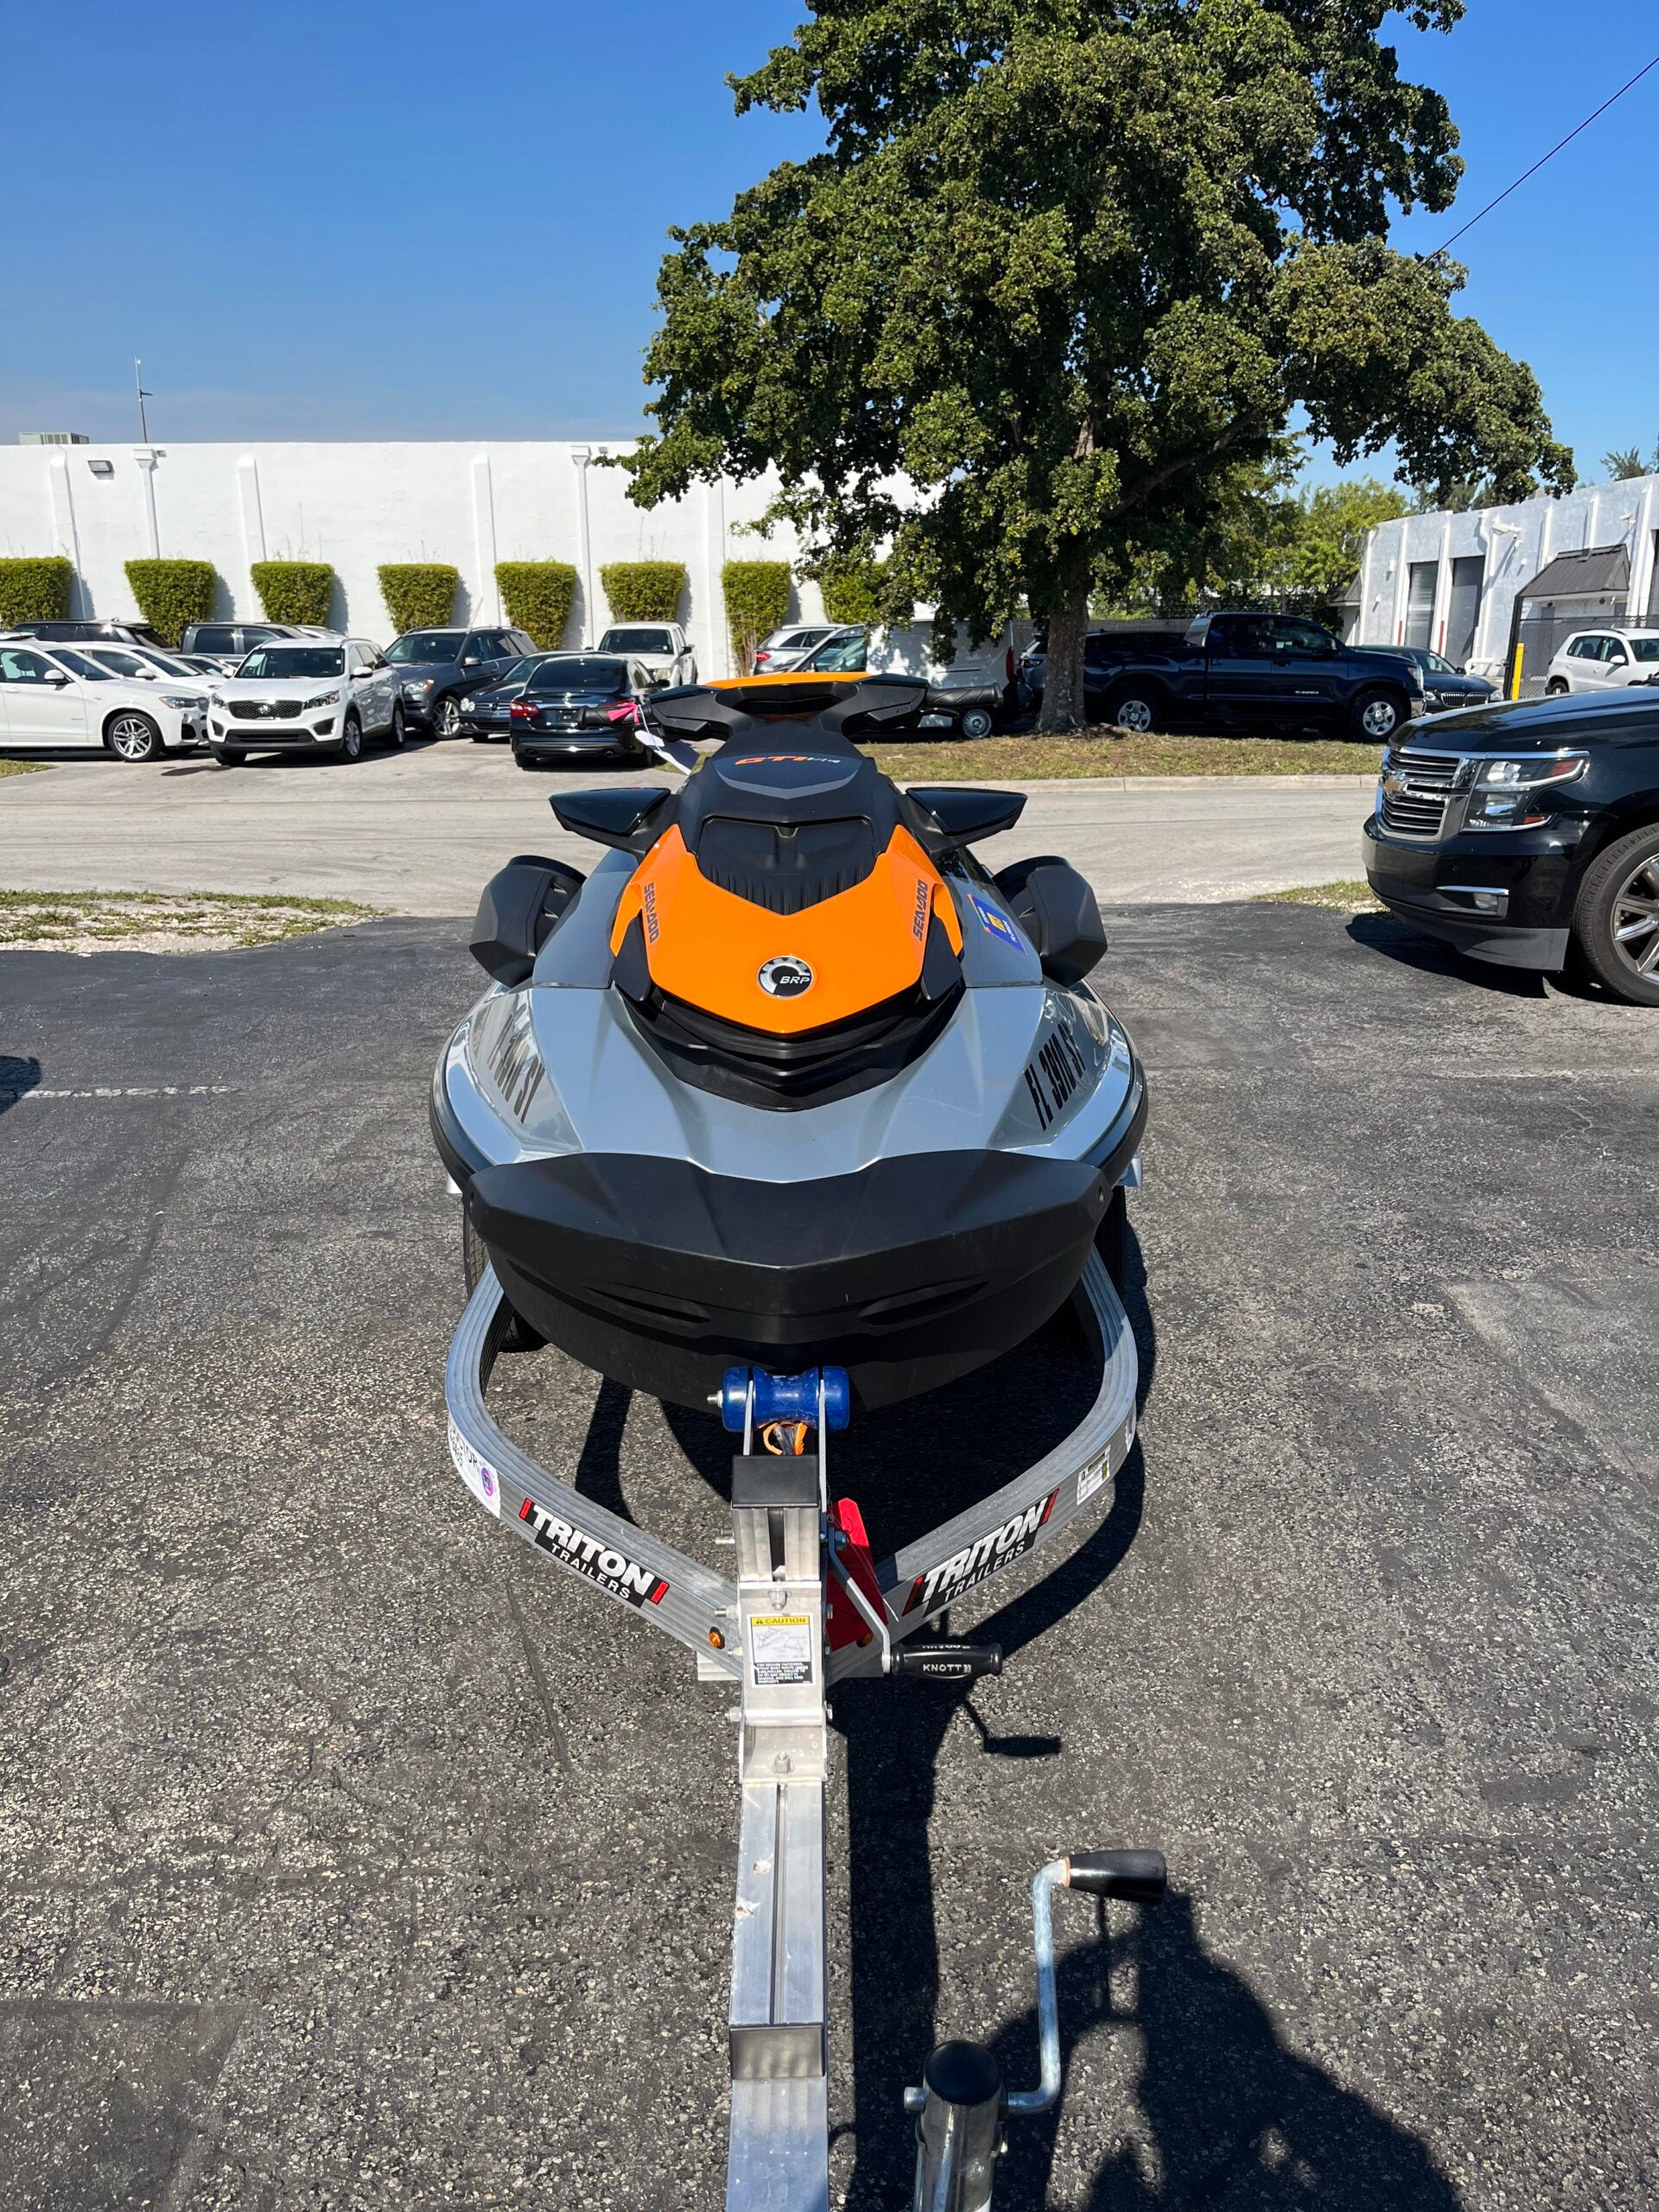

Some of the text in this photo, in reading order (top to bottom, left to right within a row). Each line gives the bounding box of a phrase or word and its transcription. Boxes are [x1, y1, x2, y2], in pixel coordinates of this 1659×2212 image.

[734, 756, 808, 766] GTI
[779, 976, 810, 984] BRP
[513, 1053, 546, 1124] SY
[1024, 1063, 1054, 1133] FL
[1038, 1032, 1077, 1111] 3910
[533, 1504, 655, 1596] TRITON
[550, 1542, 631, 1599] TRAILERS
[921, 1497, 1049, 1603] TRITON
[944, 1541, 1026, 1603] TRAILERS
[923, 1663, 963, 1672] KNOTT
